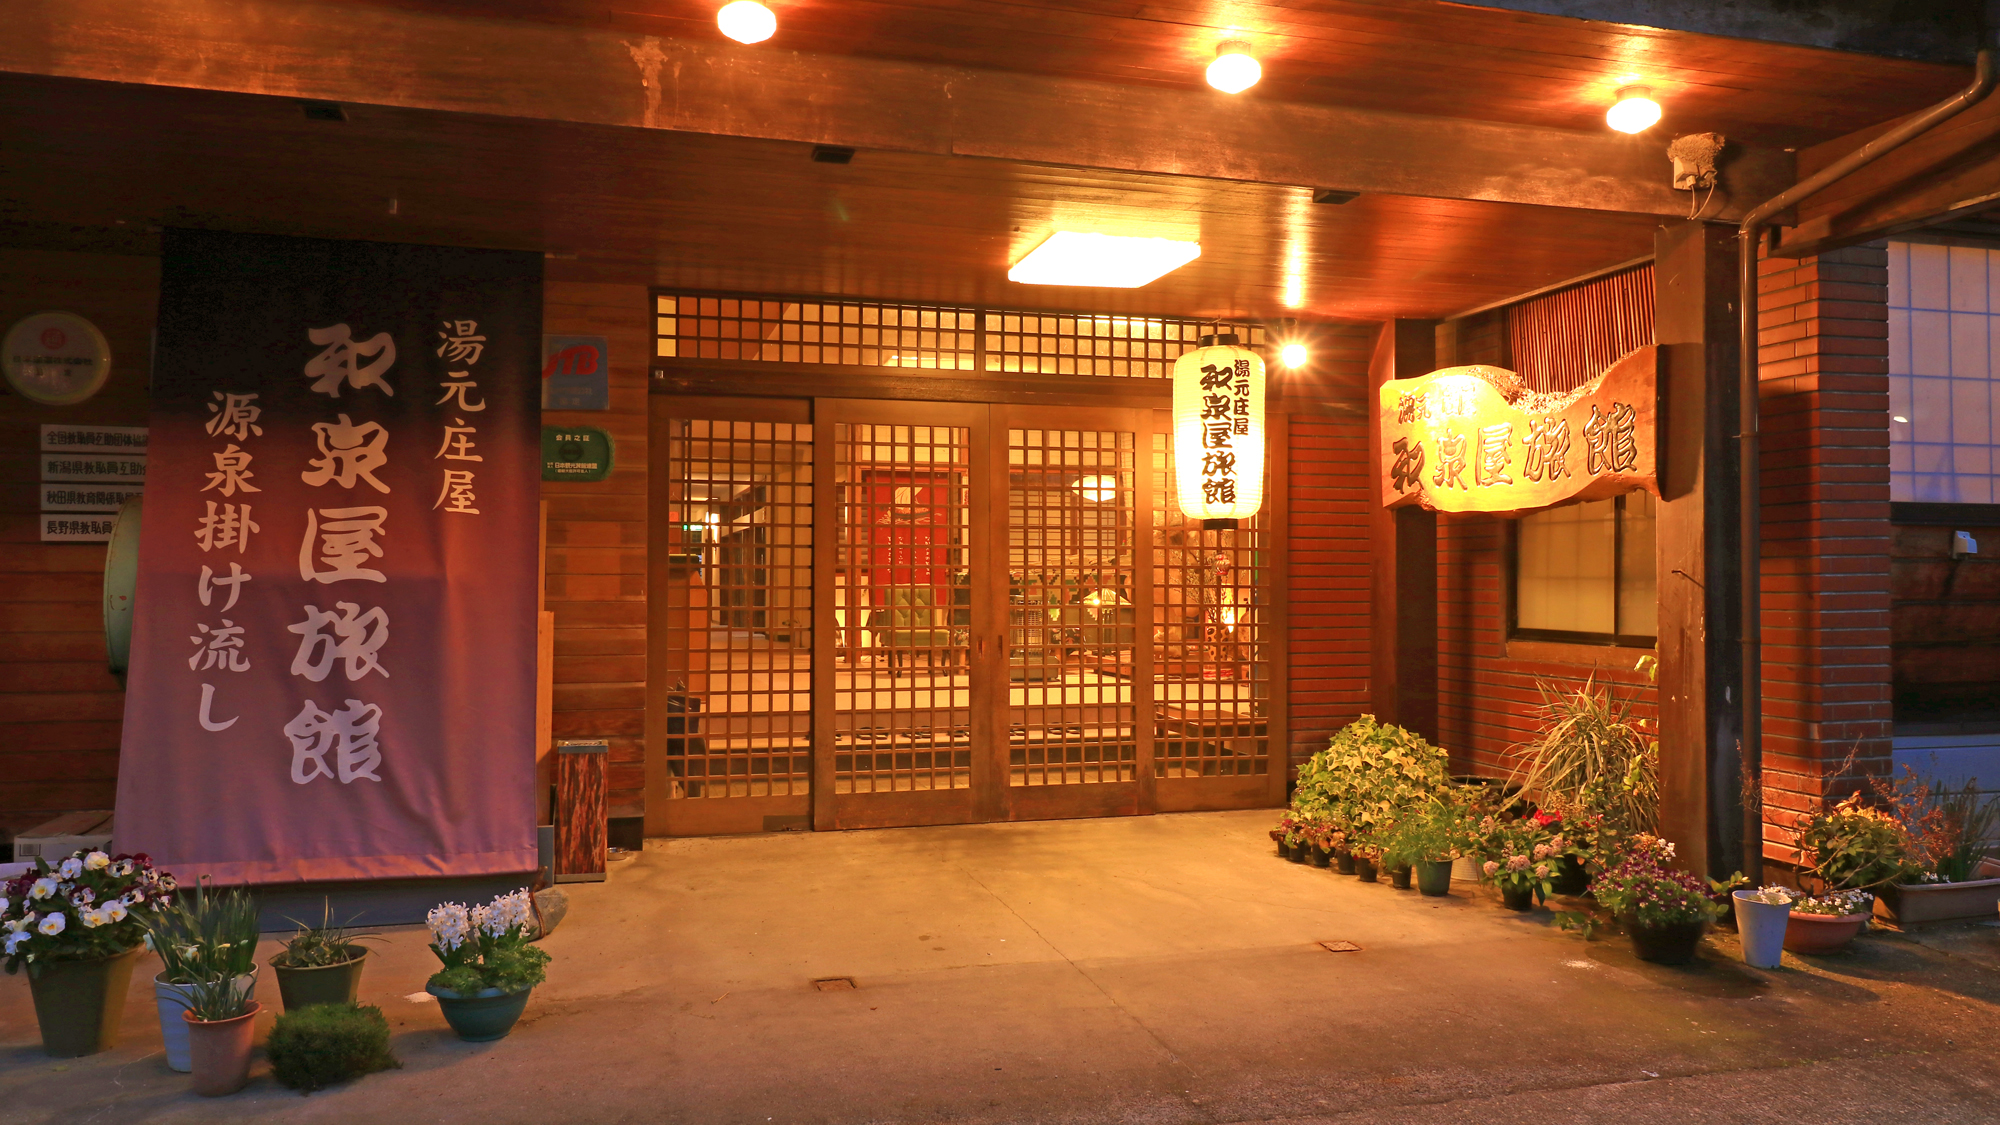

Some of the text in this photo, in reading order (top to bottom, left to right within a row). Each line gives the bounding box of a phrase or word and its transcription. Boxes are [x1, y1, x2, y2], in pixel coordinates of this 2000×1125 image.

[432, 318, 488, 516] 湯元庄屋
[1199, 363, 1238, 505] 和泉屋旅館
[1233, 359, 1250, 436] 湯元庄屋
[1391, 402, 1638, 495] 和泉屋旅館
[46, 490, 143, 506] 秋田県教育関係職
[187, 390, 264, 732] 源泉掛け流し
[283, 322, 397, 786] 和泉屋旅館
